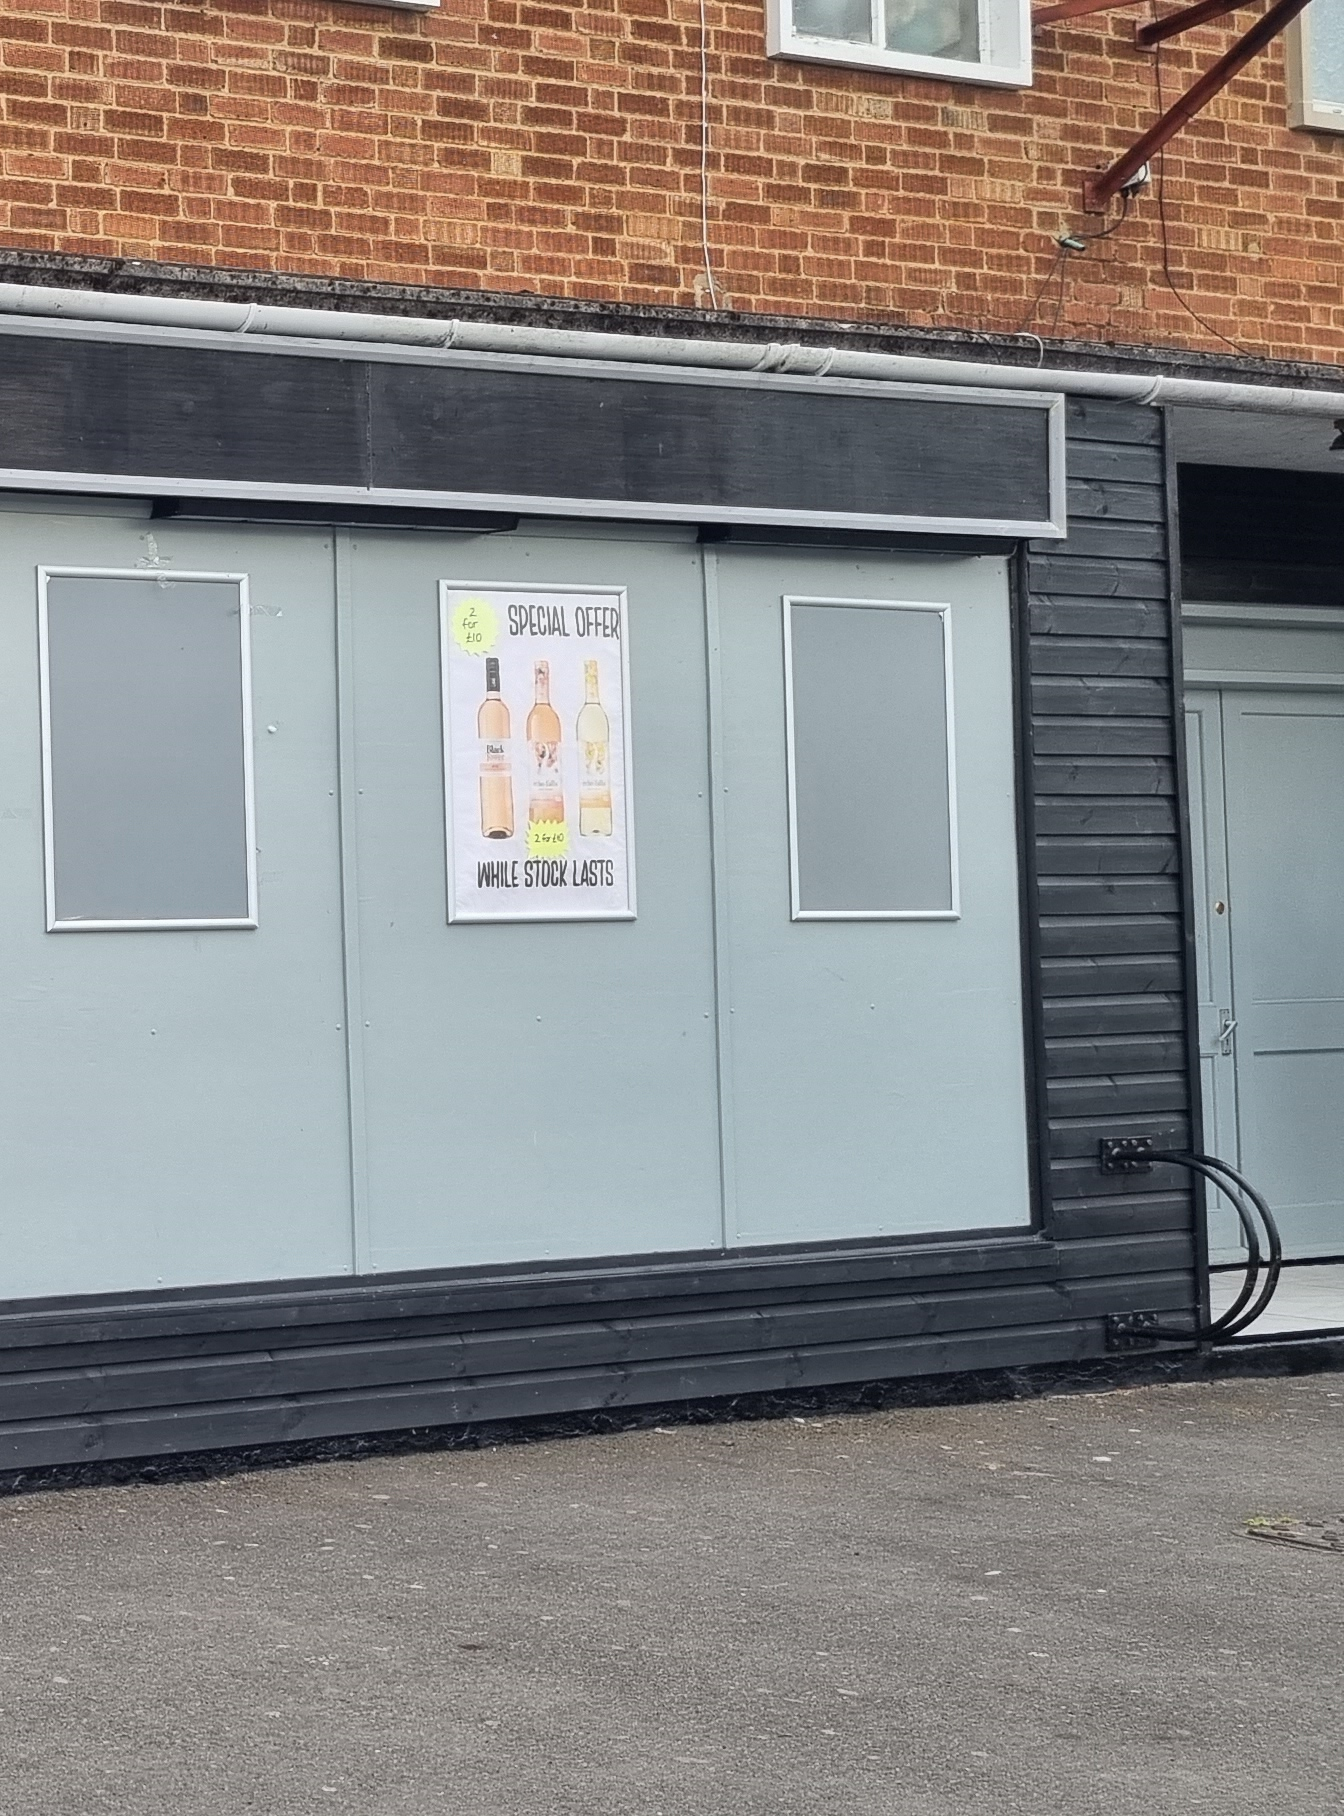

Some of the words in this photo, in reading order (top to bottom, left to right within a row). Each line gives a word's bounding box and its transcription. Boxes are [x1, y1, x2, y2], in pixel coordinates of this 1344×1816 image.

[469, 607, 477, 617] 2
[508, 604, 570, 637] SPECIAL
[575, 606, 620, 640] OFFER
[466, 633, 483, 643] £10
[535, 834, 540, 842] 2
[477, 860, 519, 889] WHILE
[524, 860, 568, 887] STOCK
[572, 860, 614, 887] LASTS
